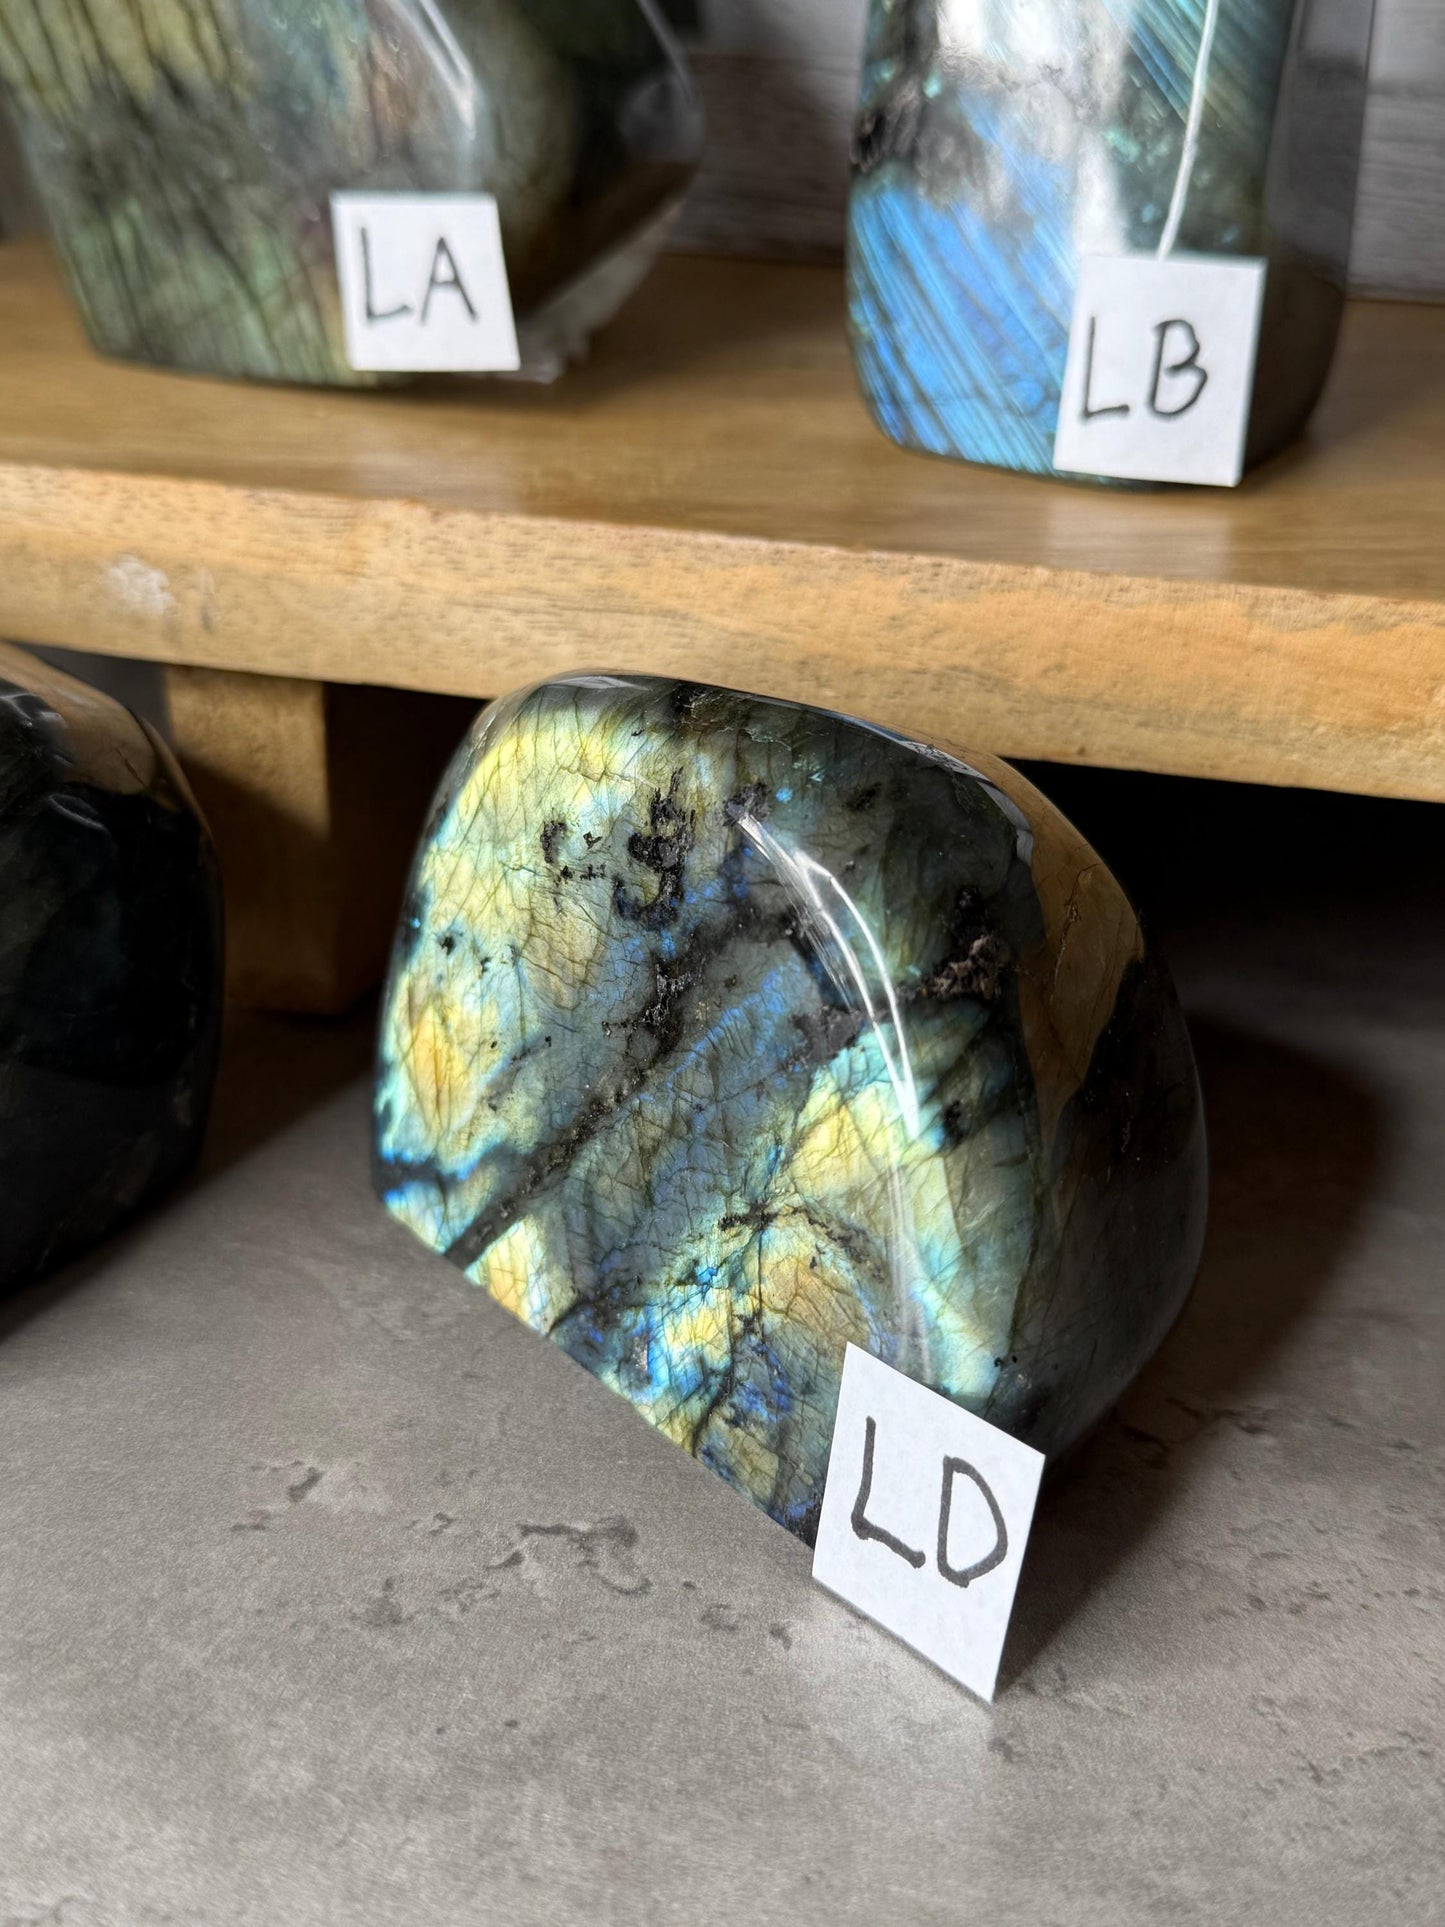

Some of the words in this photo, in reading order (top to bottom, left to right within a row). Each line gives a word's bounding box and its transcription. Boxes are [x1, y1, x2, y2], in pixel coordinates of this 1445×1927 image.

[359, 226, 478, 327] LA
[1078, 316, 1209, 423] LB
[849, 1415, 1009, 1590] LD
